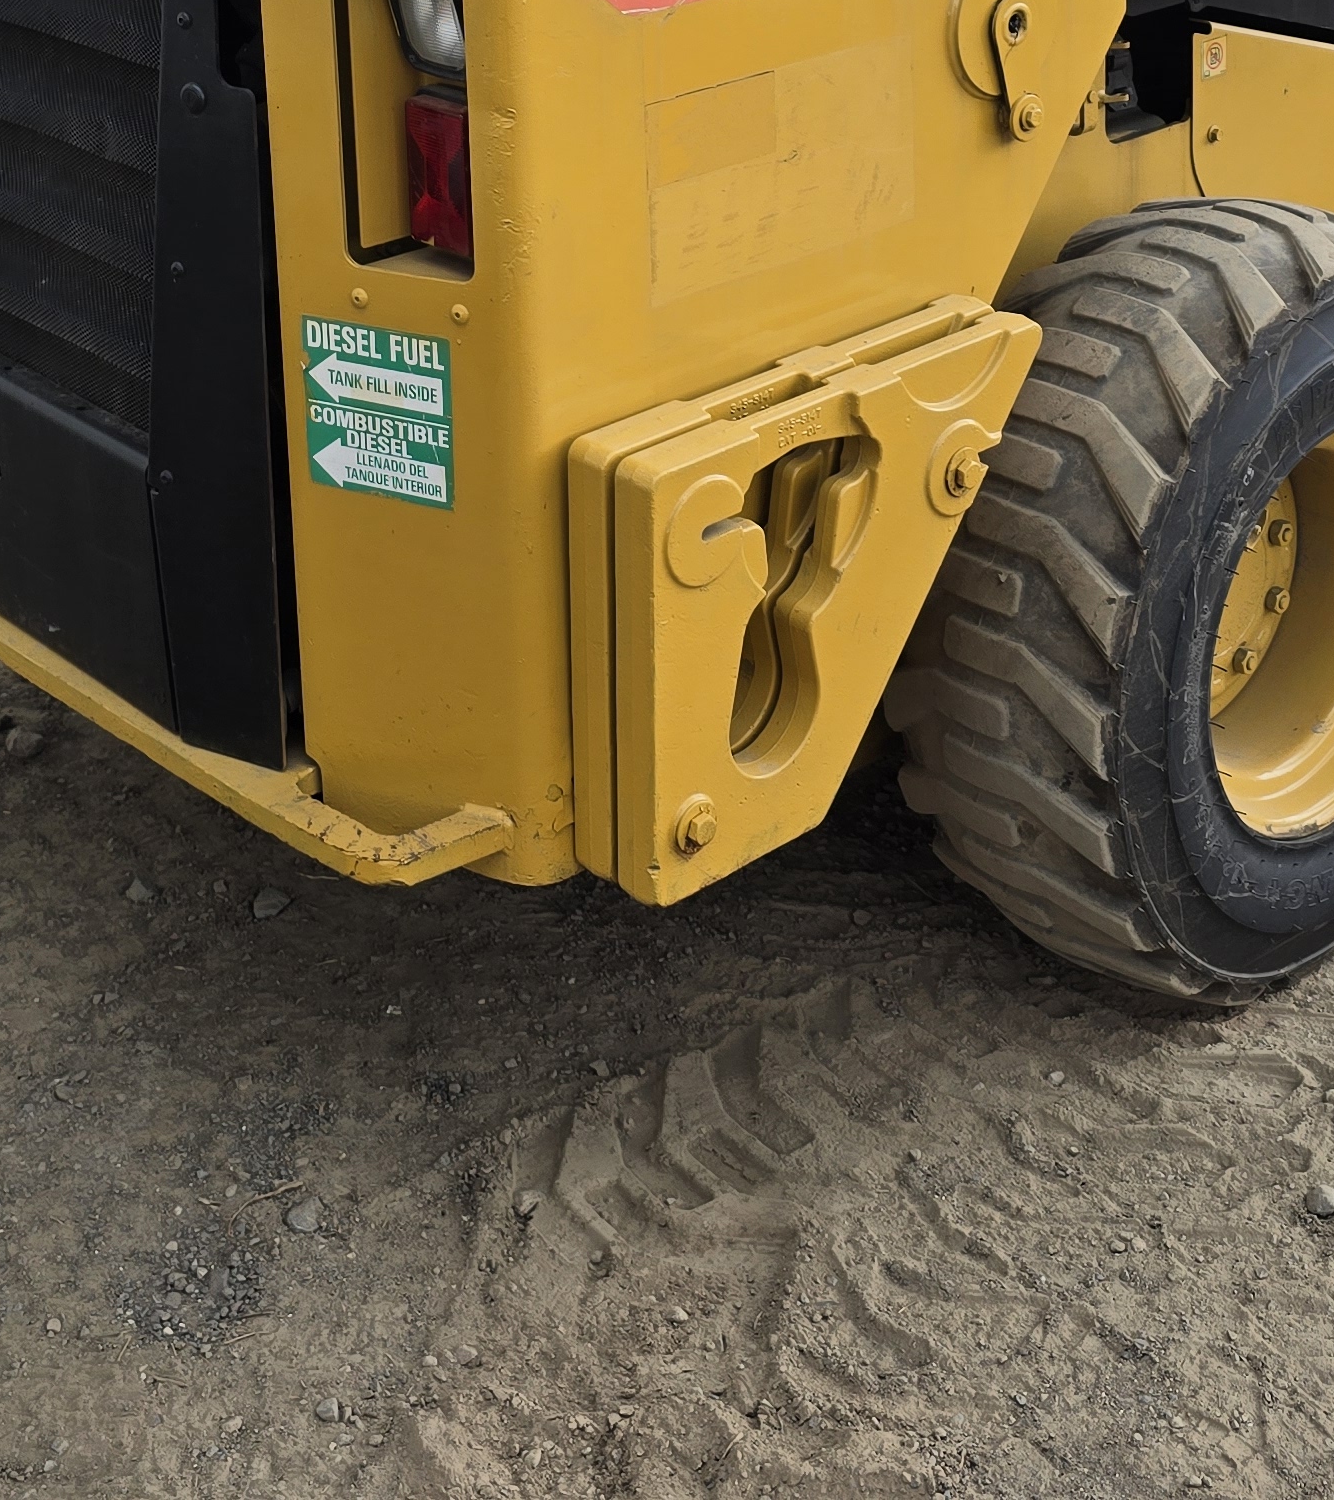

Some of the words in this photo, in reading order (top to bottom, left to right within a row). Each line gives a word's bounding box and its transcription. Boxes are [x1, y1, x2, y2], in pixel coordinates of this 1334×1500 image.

[306, 319, 382, 359] DIESEL
[389, 334, 445, 371] FUEL
[327, 368, 363, 390] TANK
[366, 375, 391, 395] FILL
[394, 380, 438, 404] INSIDE
[309, 404, 450, 449] COMBUSTIBLE
[346, 429, 413, 459] DIESEL
[344, 465, 390, 486] TANQUE
[391, 475, 443, 498] INTERIOR
[356, 451, 406, 474] LLENADO
[409, 465, 429, 479] DEL
